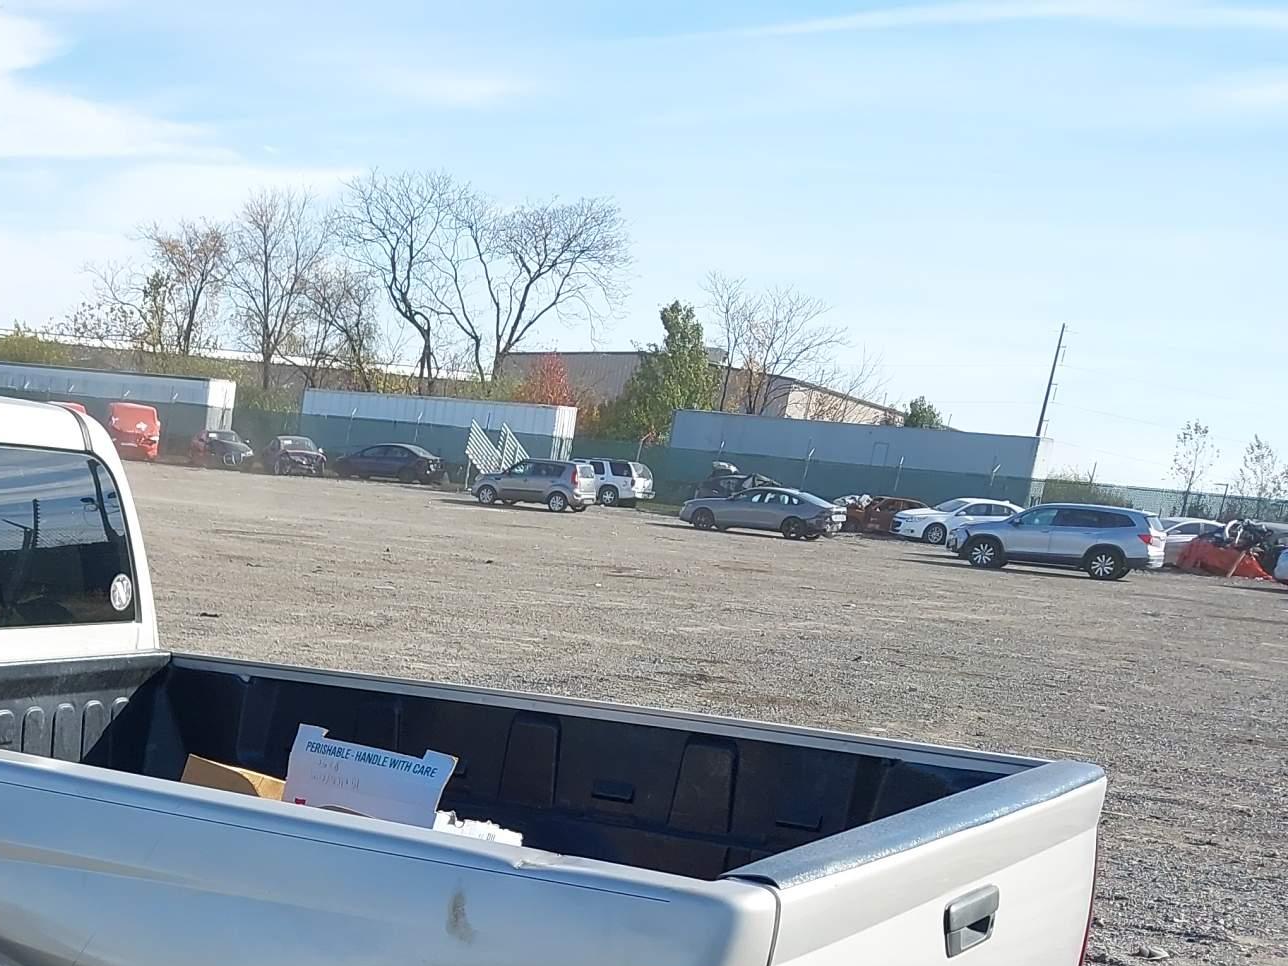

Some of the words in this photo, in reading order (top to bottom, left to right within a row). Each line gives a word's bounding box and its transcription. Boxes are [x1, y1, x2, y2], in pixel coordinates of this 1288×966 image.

[115, 580, 128, 605] N
[305, 741, 352, 760] PERISHABLE
[354, 751, 389, 768] HANDLE
[388, 757, 413, 773] WITH
[412, 763, 439, 778] CARE
